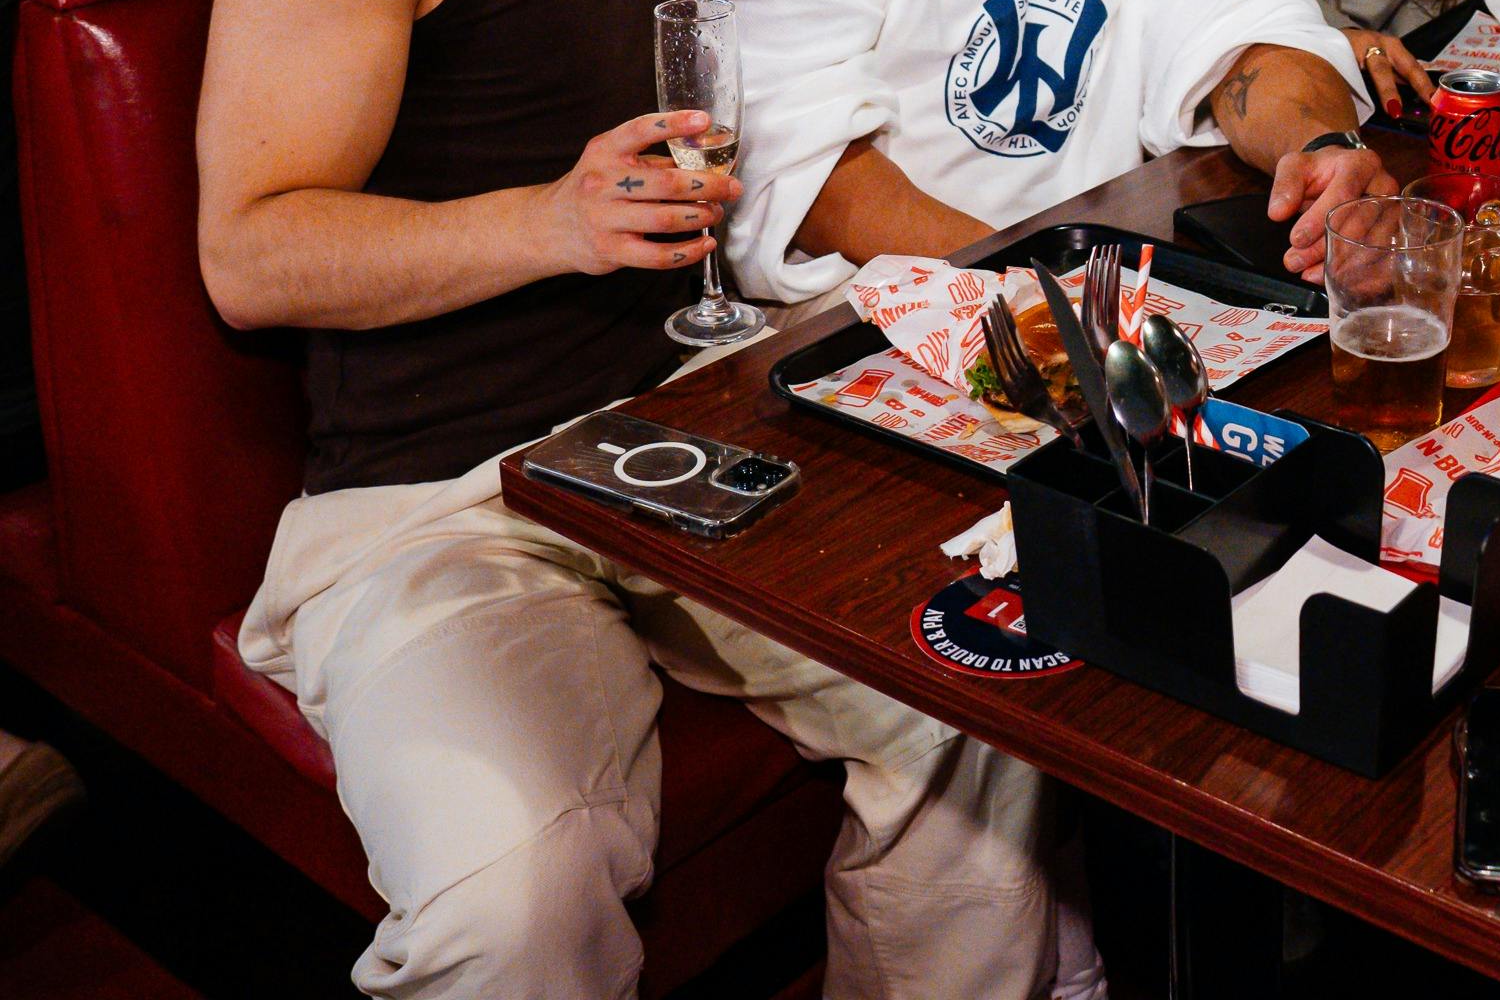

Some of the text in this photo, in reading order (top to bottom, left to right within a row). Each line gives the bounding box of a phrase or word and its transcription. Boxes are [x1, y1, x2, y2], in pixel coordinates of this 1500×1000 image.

[954, 76, 970, 120] AVEC
[1008, 140, 1038, 149] ITH
[923, 608, 1070, 672] SCAN TO ORDER & PAY
